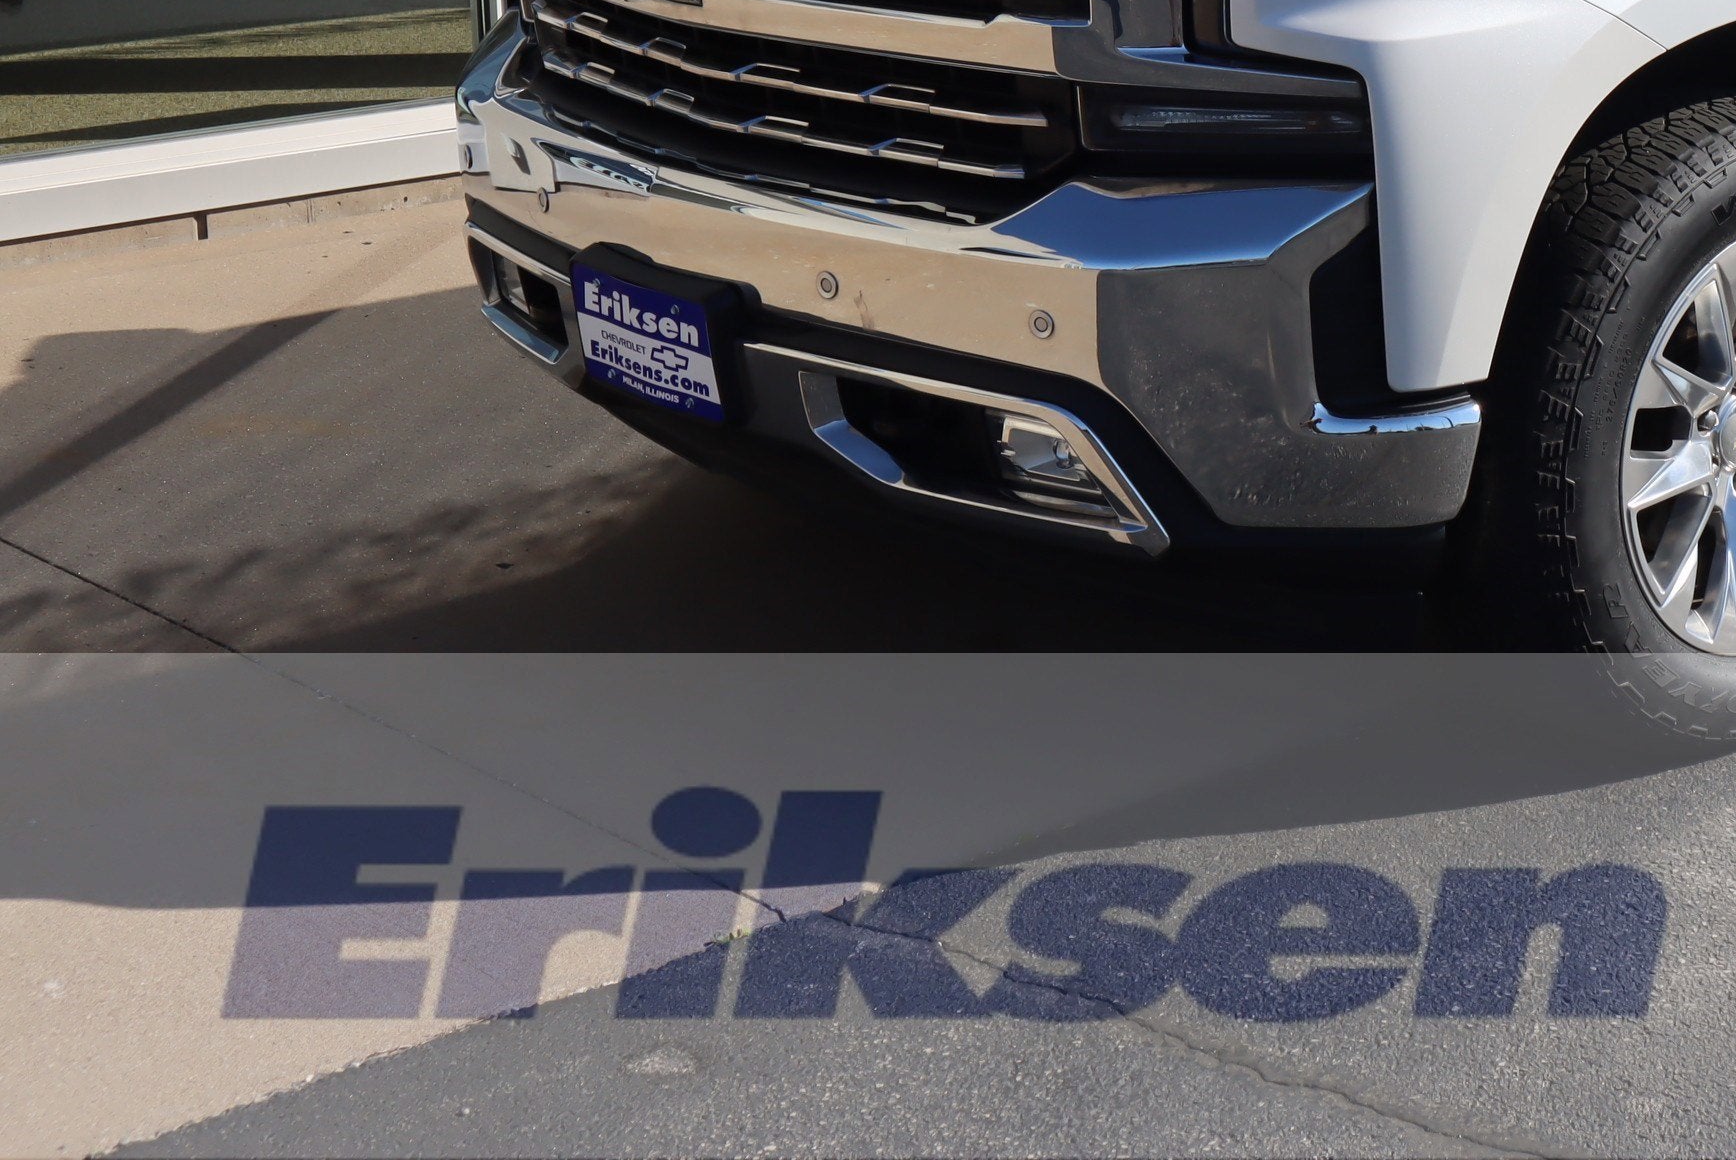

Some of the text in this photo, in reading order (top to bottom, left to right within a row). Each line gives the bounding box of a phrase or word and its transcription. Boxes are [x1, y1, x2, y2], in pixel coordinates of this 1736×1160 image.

[584, 281, 699, 347] Eriksen
[601, 330, 647, 355] CHEVROLET
[590, 339, 710, 397] Eriksens.com
[645, 386, 680, 403] ILLINOIS
